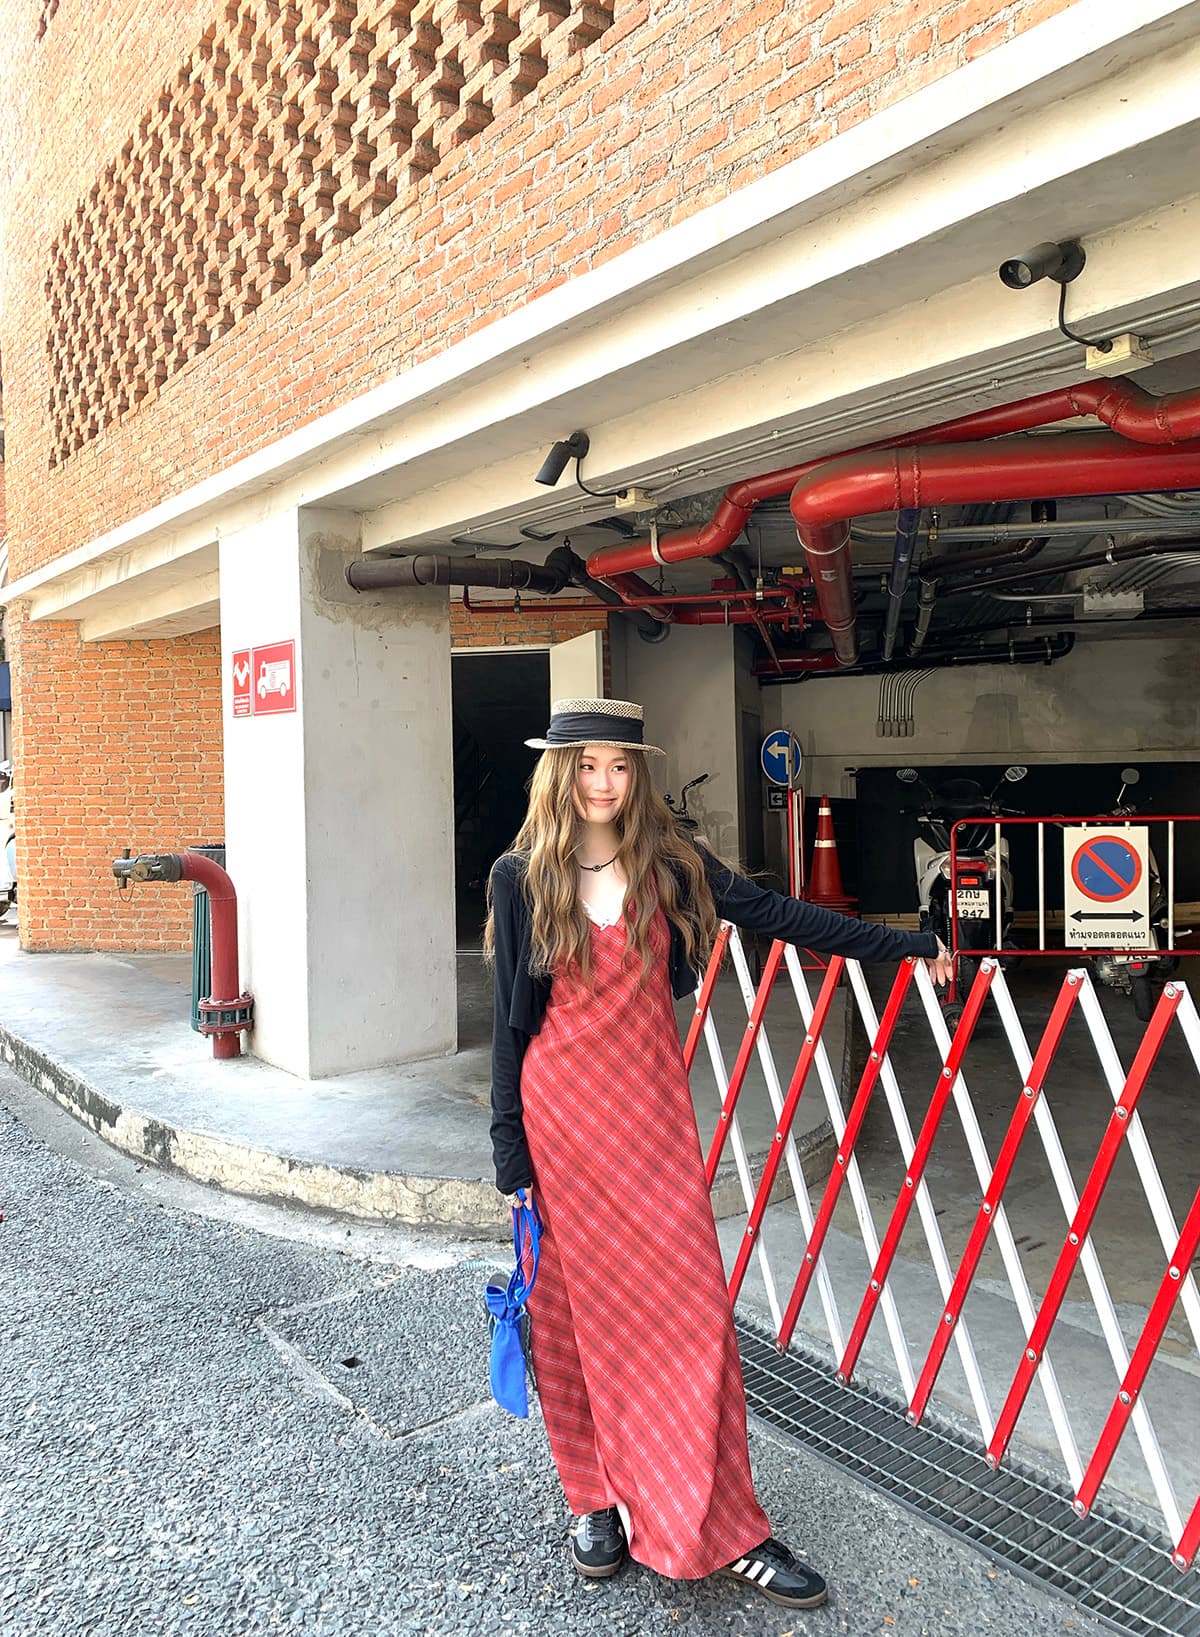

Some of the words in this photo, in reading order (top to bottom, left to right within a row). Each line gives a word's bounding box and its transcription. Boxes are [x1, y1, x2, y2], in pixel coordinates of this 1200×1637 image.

[1069, 928, 1146, 939] ห้ามจอดตลอดแนว
